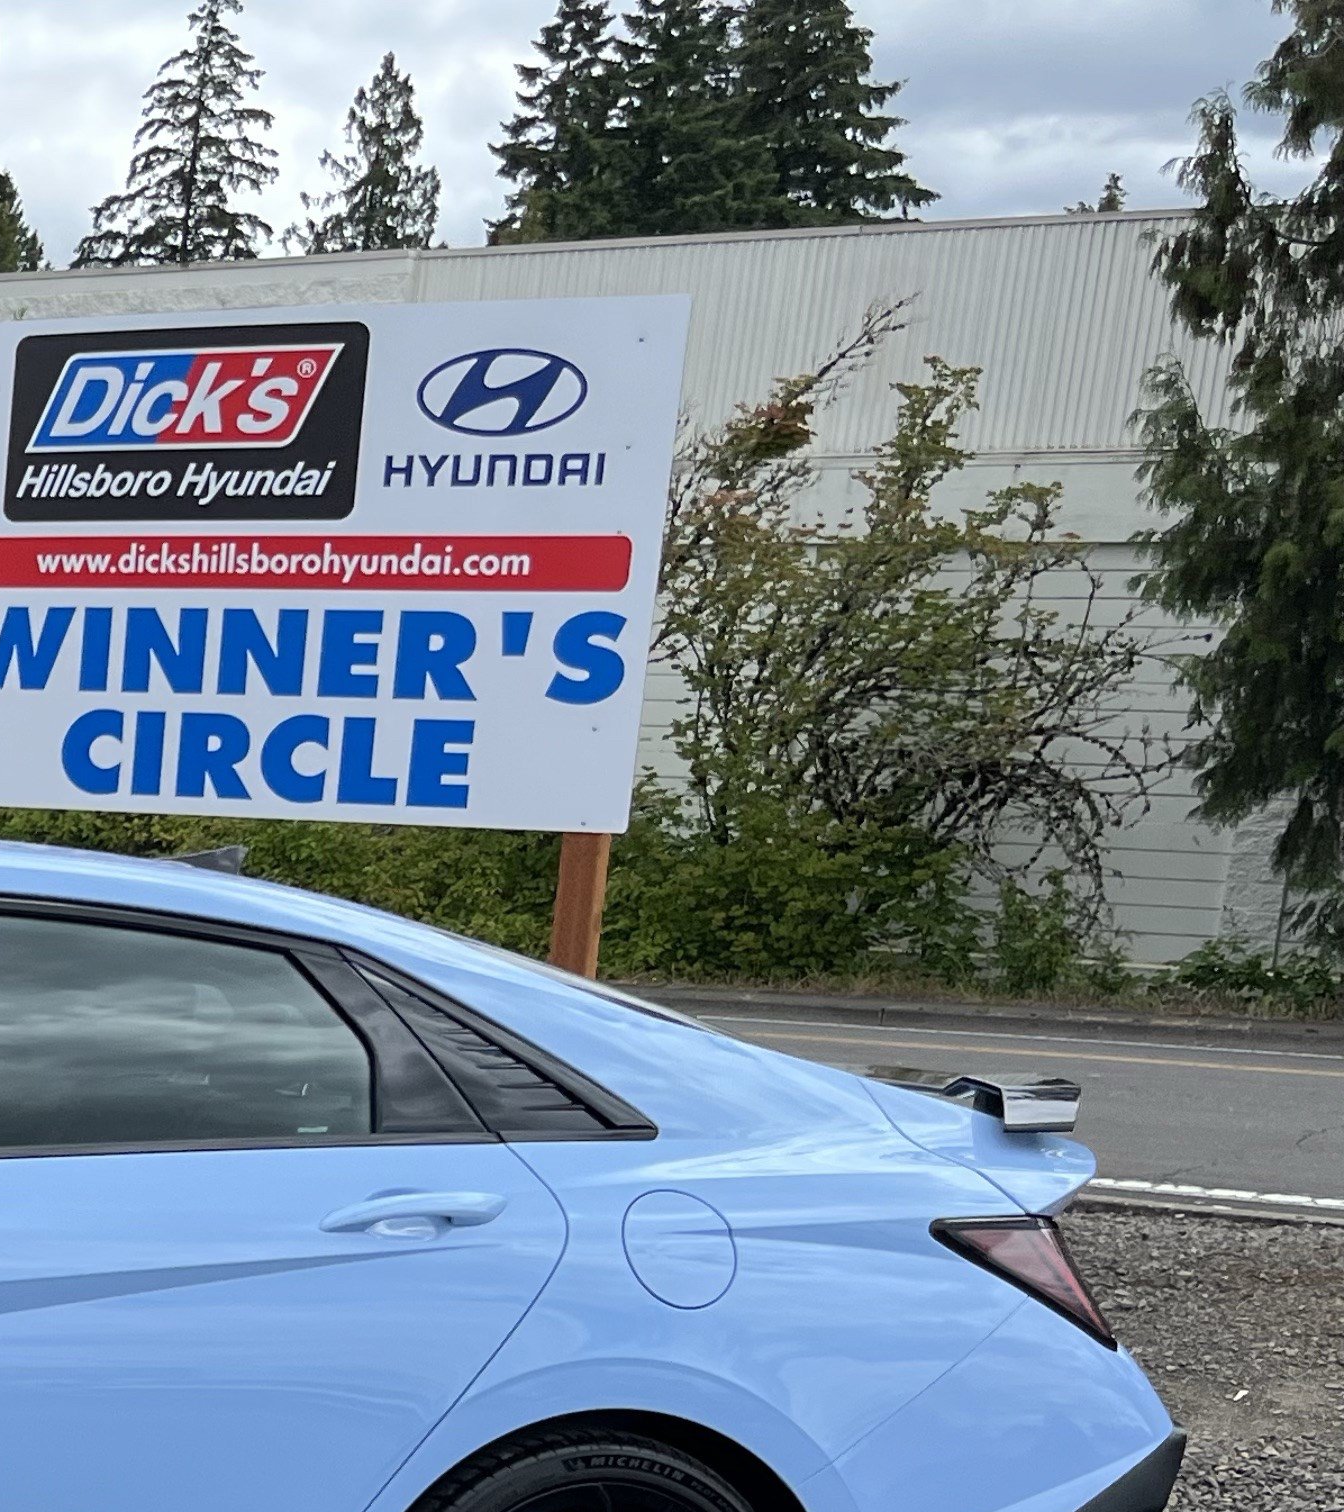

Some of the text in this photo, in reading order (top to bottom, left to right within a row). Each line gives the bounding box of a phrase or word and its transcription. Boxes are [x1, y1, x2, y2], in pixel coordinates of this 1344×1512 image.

[16, 461, 337, 505] Hillsboro Hyundai
[383, 453, 606, 487] HYUNDAI
[36, 542, 531, 583] www.dickshillsborohyundai.com
[62, 709, 475, 809] CIRCLE
